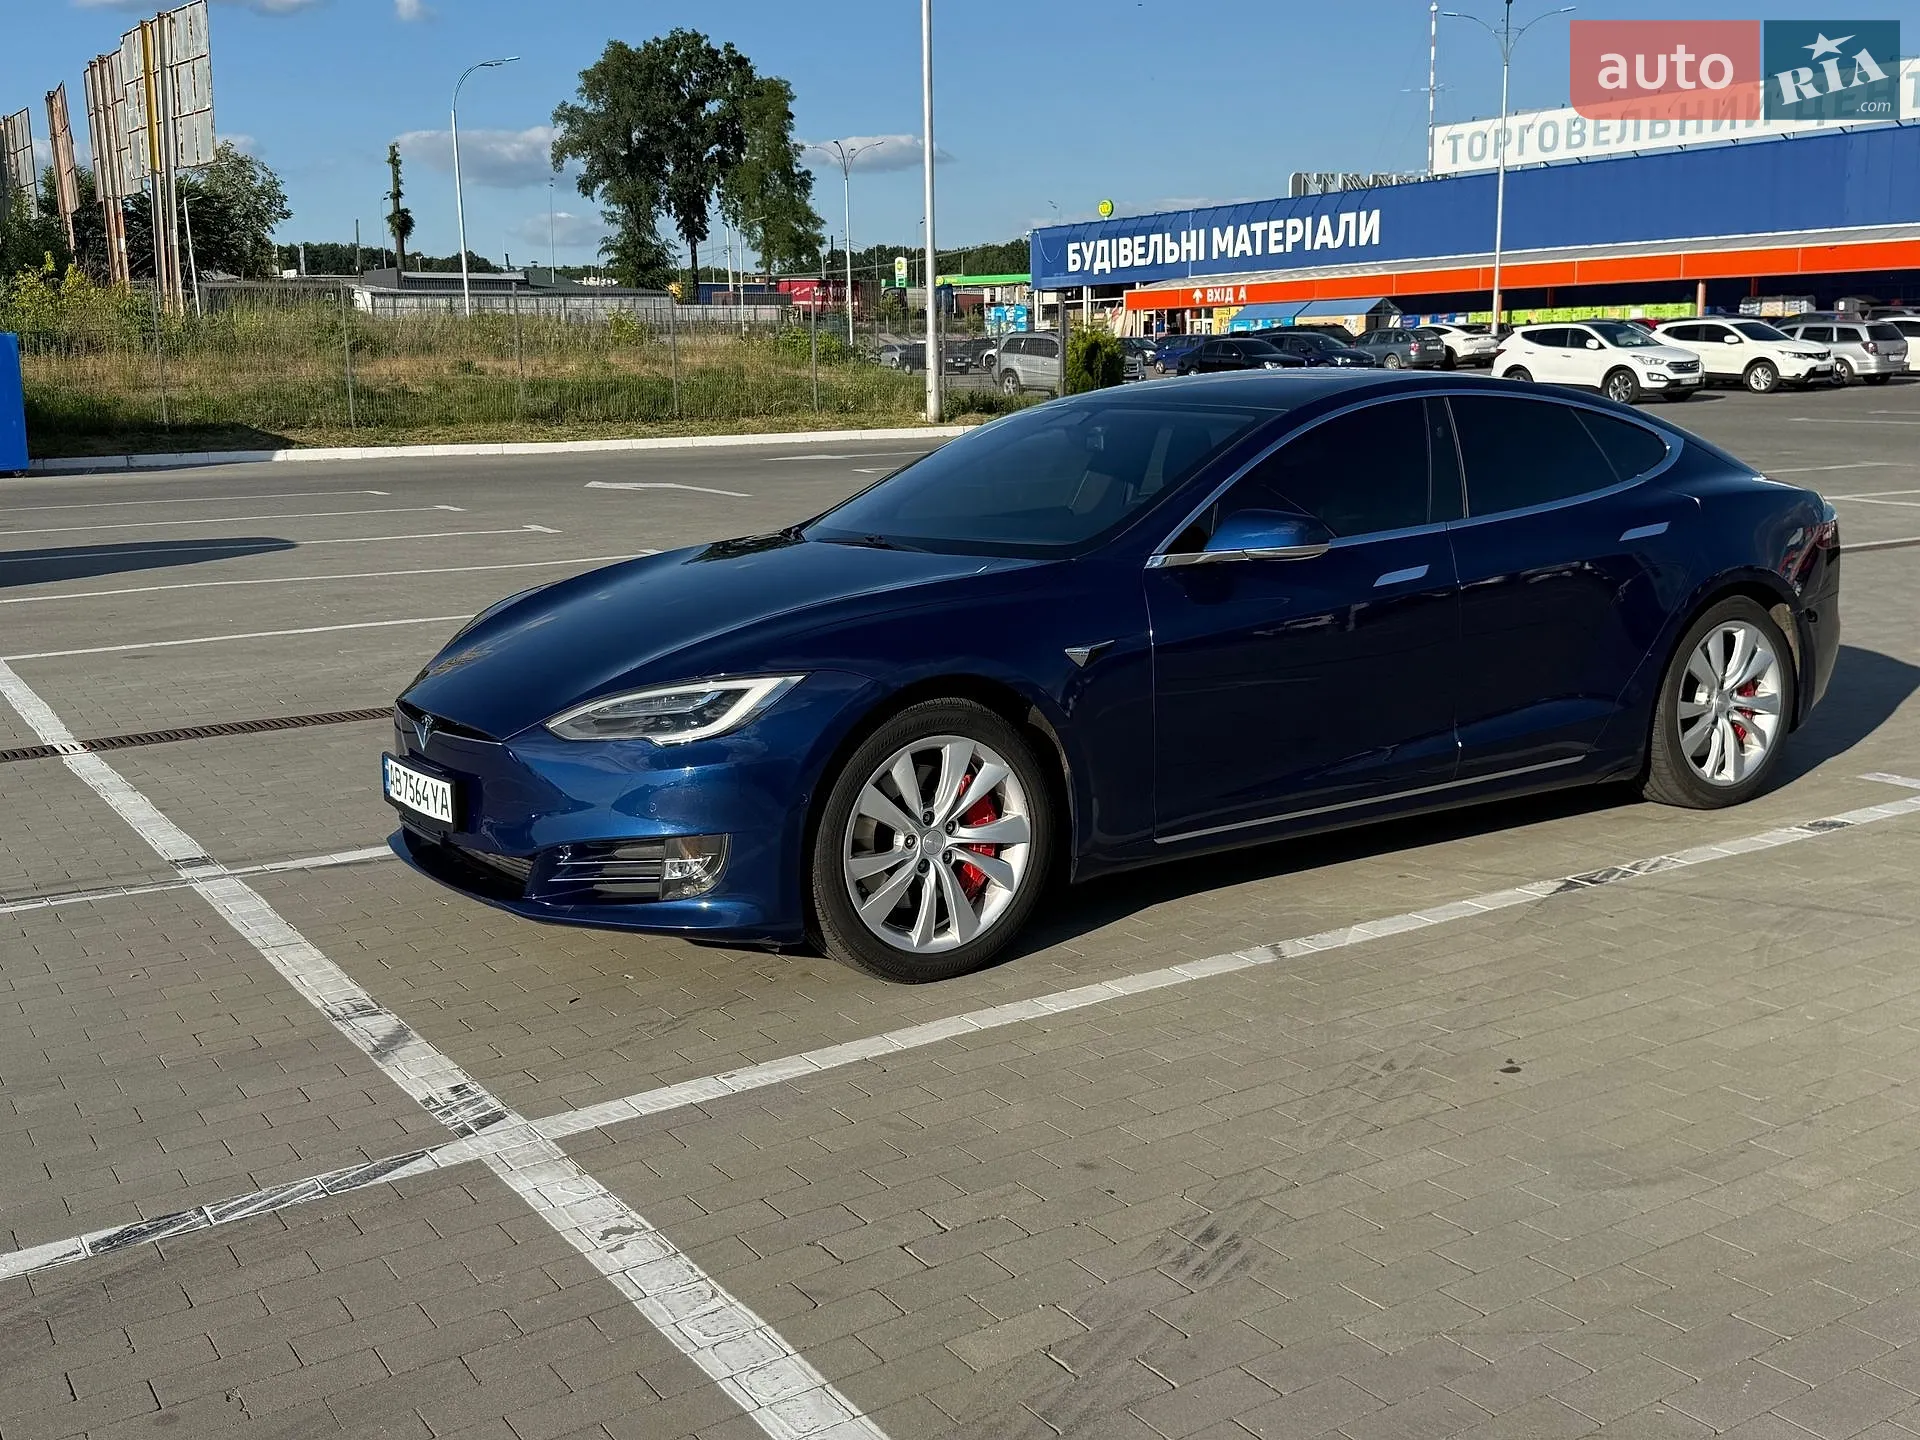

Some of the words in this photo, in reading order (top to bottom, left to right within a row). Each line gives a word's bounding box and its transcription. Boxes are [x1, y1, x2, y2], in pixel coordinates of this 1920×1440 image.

[1447, 83, 1771, 164] ТОРГОВЕЛЬНИЙ
[1067, 229, 1205, 275] БУДІВЕЛЬНІ
[1212, 209, 1381, 260] МАТЕРІАЛИ
[1206, 287, 1234, 304] ВХІД
